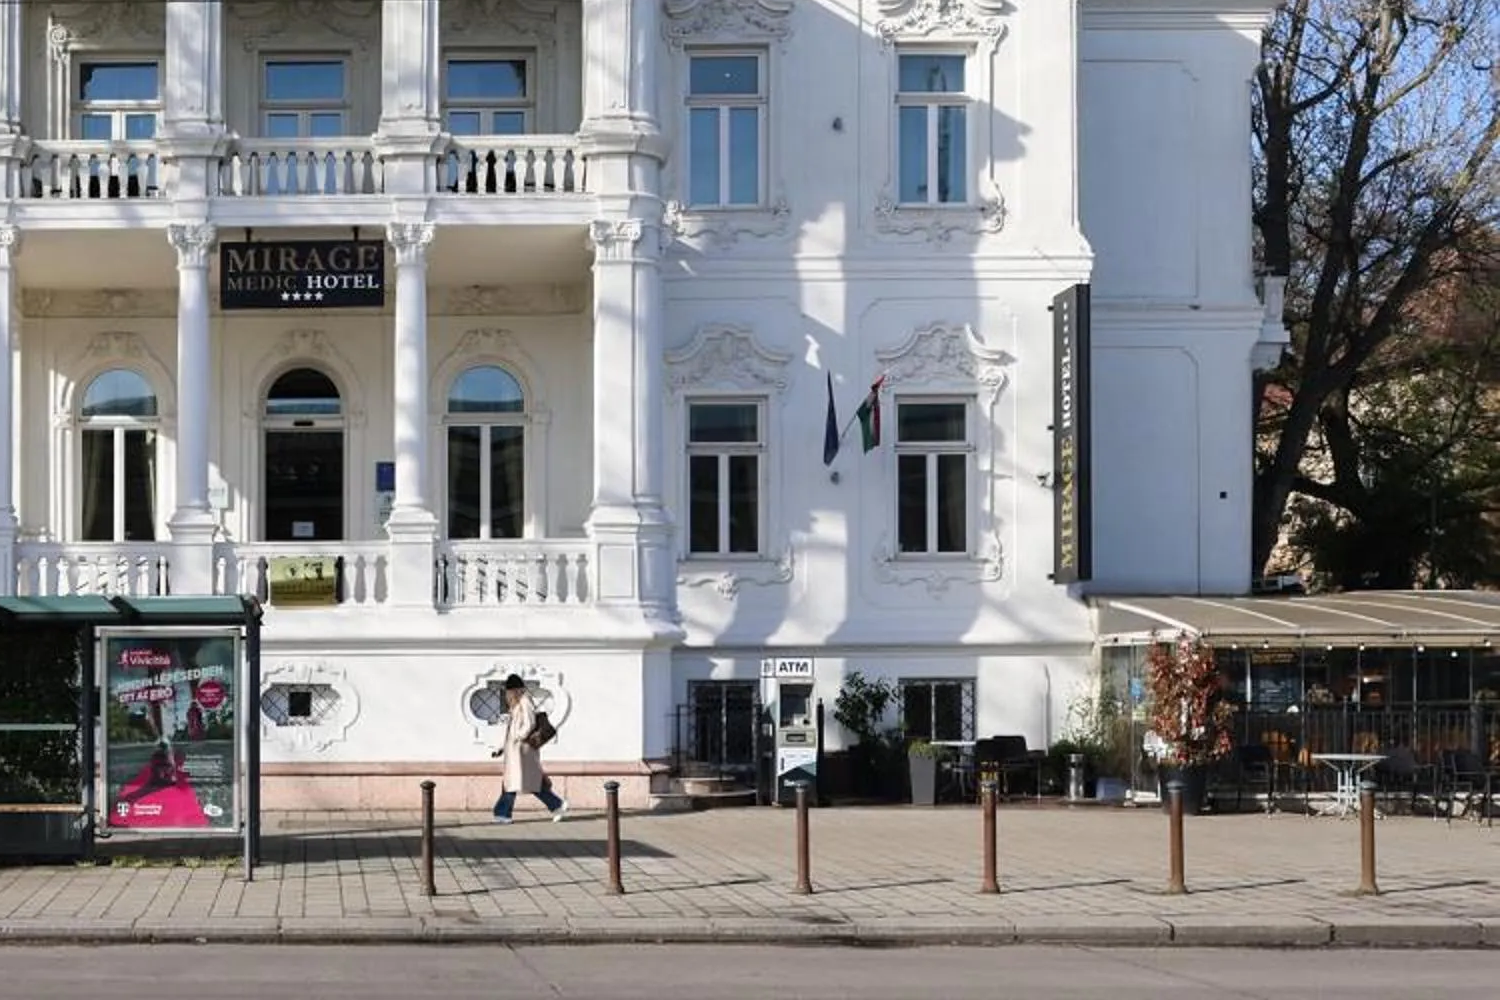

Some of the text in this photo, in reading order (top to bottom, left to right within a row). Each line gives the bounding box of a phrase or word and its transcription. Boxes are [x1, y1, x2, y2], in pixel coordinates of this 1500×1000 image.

[227, 245, 380, 273] MIRAGE
[227, 274, 380, 292] MEDIC HOTEL
[1061, 347, 1073, 569] MIRAGE HOTEL
[779, 661, 809, 673] ATM
